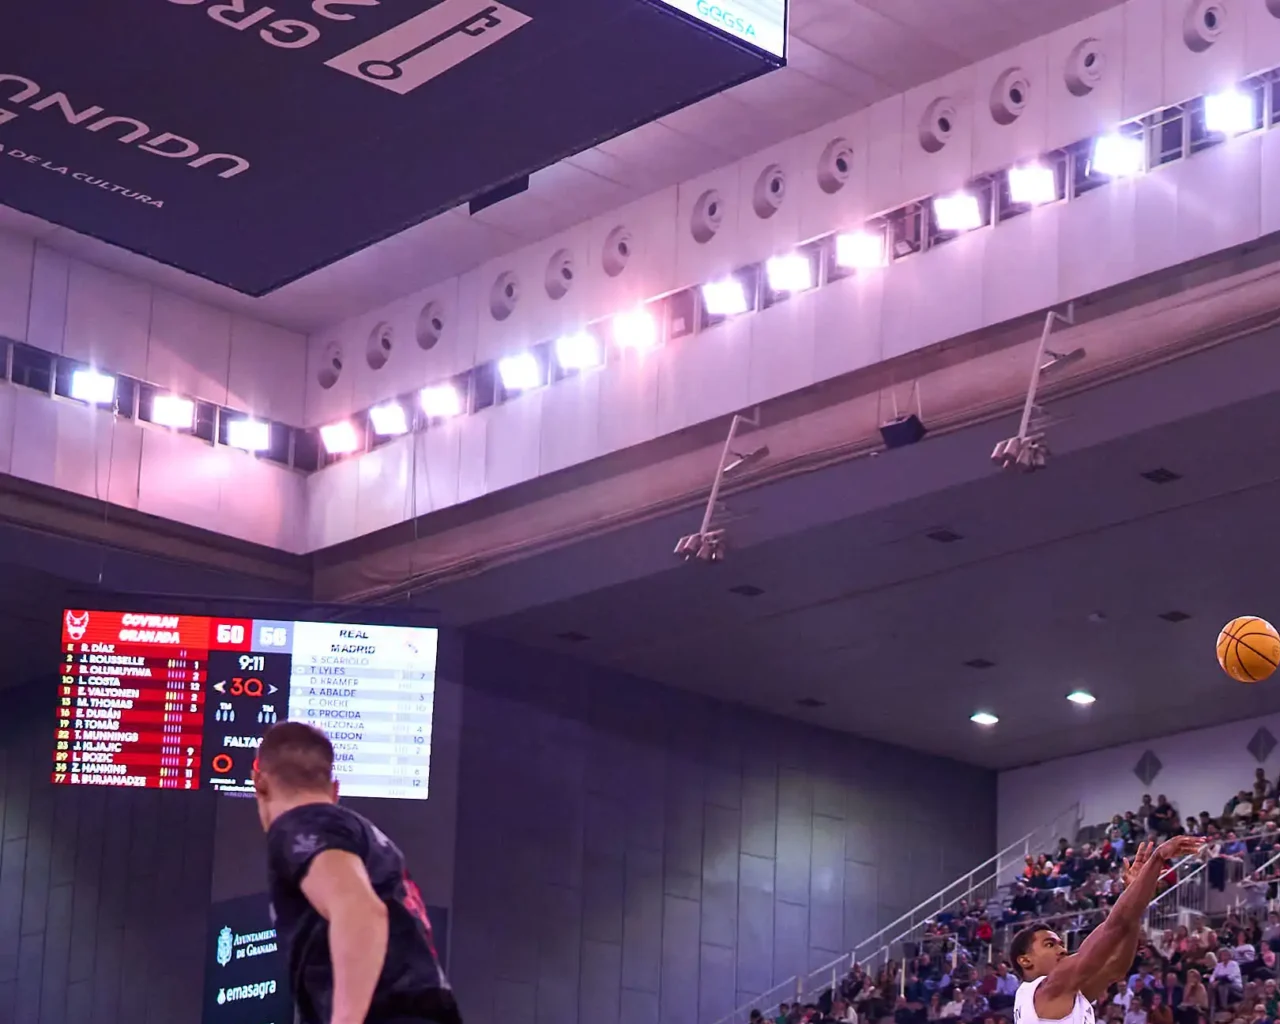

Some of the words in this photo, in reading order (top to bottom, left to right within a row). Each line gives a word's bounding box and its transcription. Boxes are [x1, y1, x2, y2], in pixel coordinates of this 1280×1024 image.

[7, 150, 41, 164] DE
[41, 161, 68, 174] LA
[71, 172, 164, 208] CULTURA
[119, 630, 180, 644] GRANADA
[339, 629, 369, 639] REAL
[331, 644, 376, 655] MADRID
[239, 655, 265, 671] 9:11
[319, 666, 345, 675] LYLES
[62, 676, 74, 684] 10
[88, 676, 120, 687] COSTA
[229, 677, 264, 697] 3Q
[319, 688, 357, 697] ABALDE
[90, 698, 133, 709] THOMAS
[319, 709, 361, 719] PROCIDA
[414, 736, 424, 744] 10
[412, 779, 421, 787] 12
[233, 929, 277, 946] AYUNTAMIEN
[246, 943, 278, 957] GRANADA
[226, 980, 277, 1002] emasagra
